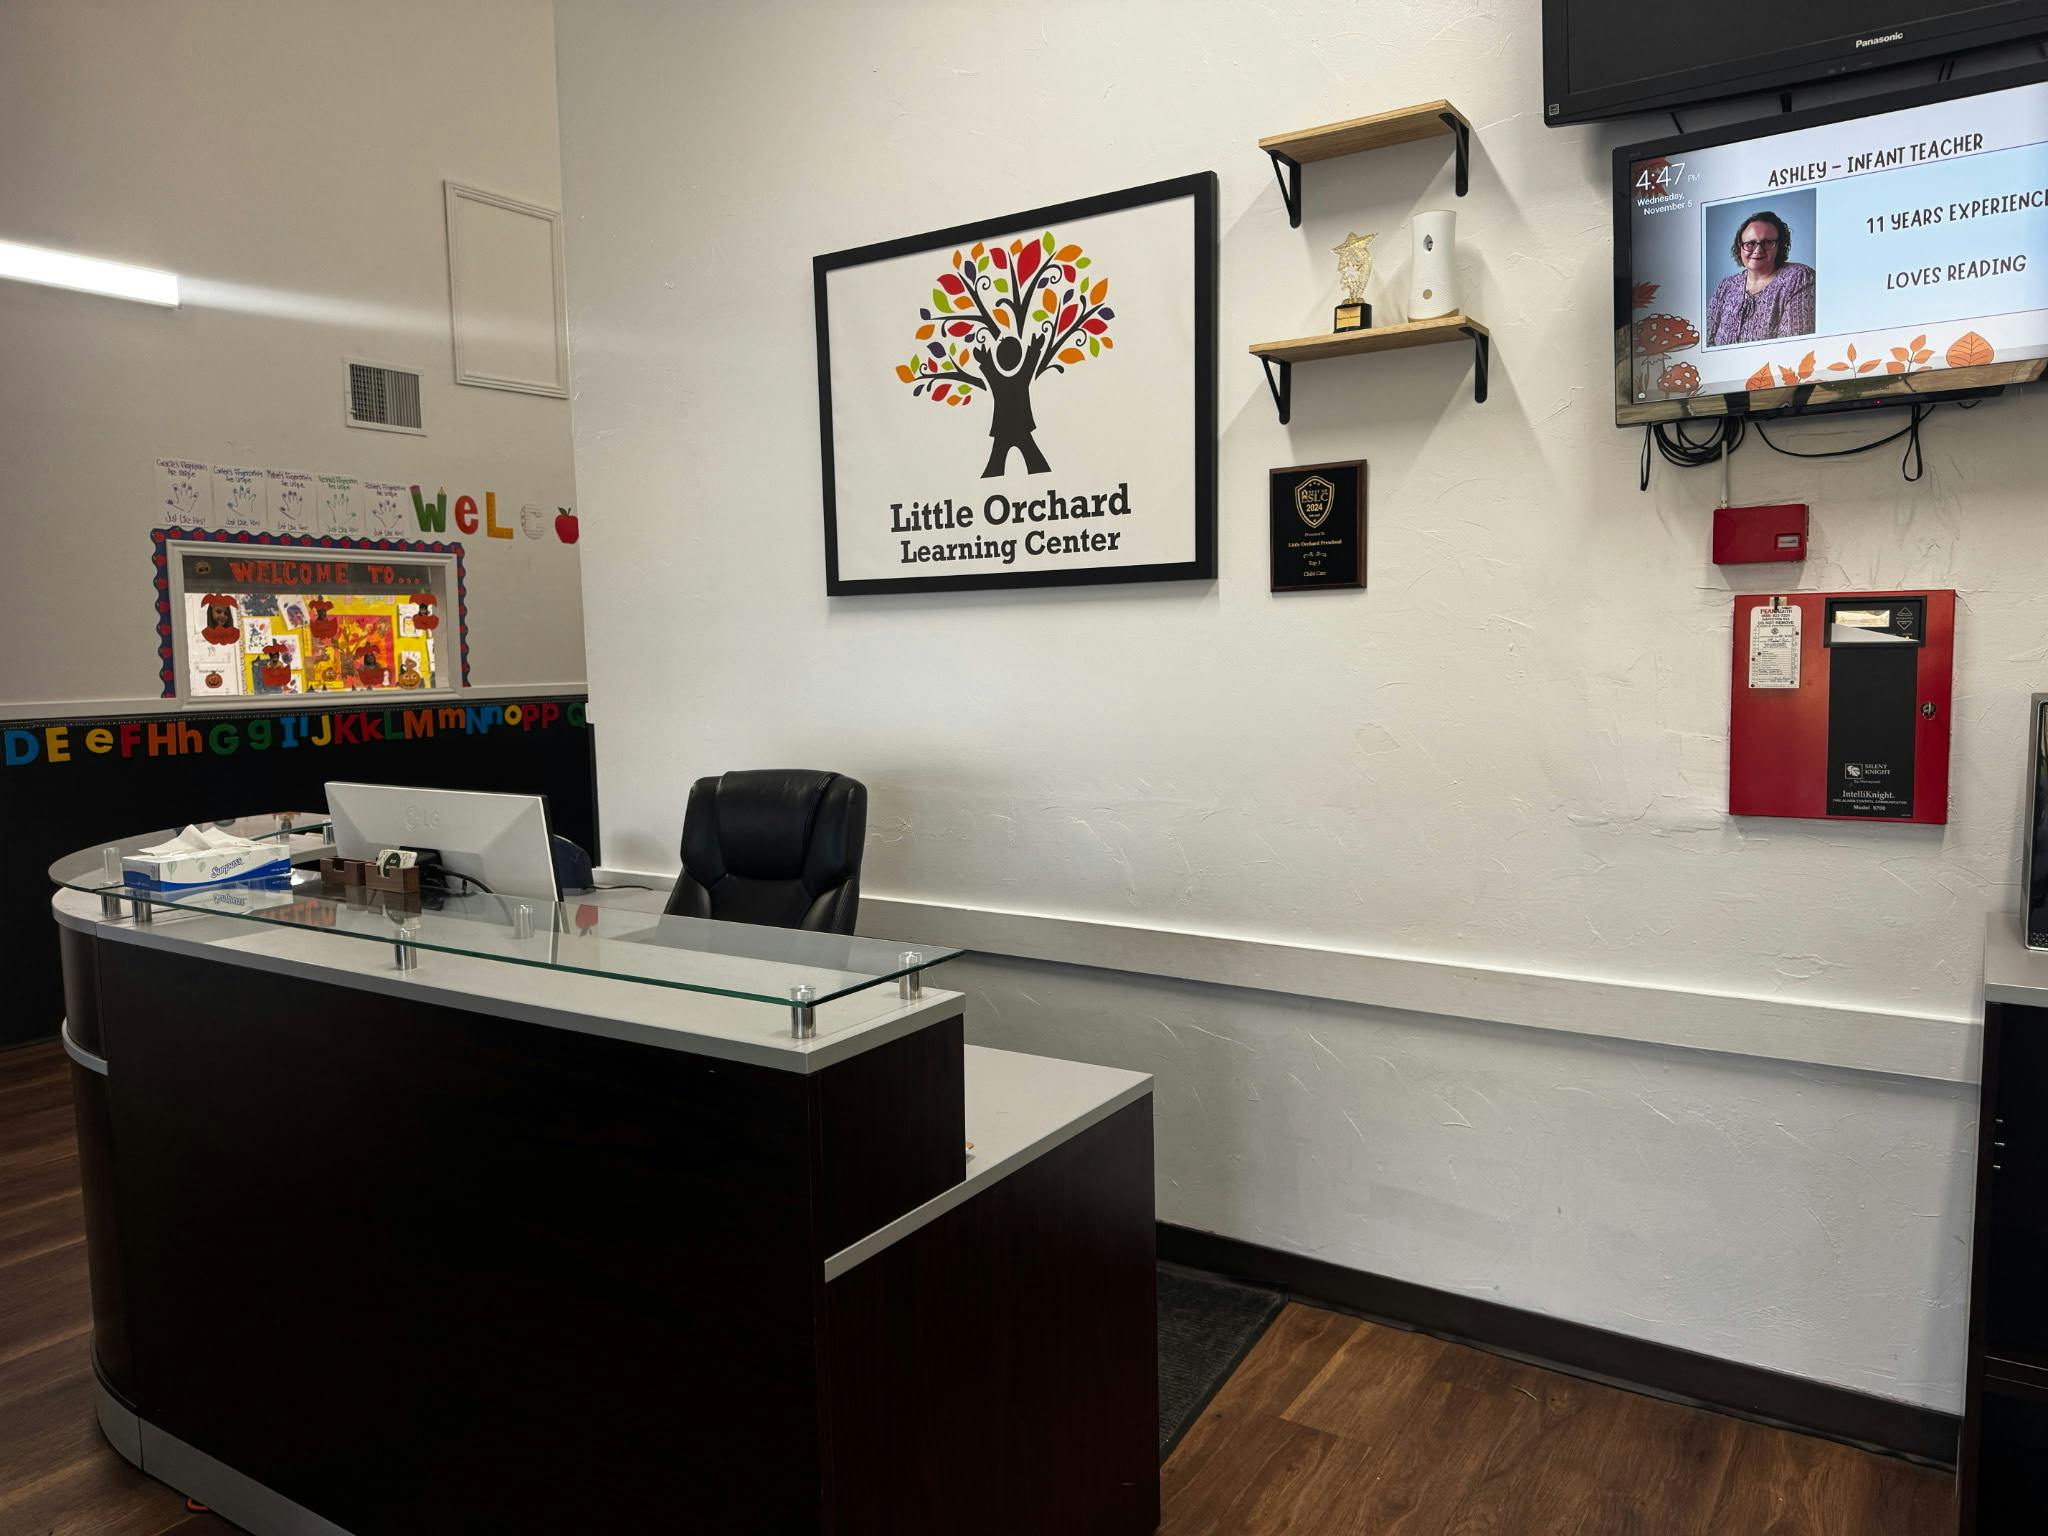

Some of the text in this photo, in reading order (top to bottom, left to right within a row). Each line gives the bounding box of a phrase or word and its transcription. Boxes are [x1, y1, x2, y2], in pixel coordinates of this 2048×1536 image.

[1855, 31, 1904, 49] Panasonic
[1767, 161, 1827, 188] ASHLEY
[1847, 146, 1906, 174] INFANT
[1909, 132, 1984, 162] TEACHER
[1635, 162, 1700, 191] 4:47 PM
[1637, 192, 1685, 207] Wednesday,
[1643, 202, 1686, 216] November
[1866, 215, 1885, 234] 11
[1890, 206, 1943, 231] YEARS
[1886, 254, 2028, 290] LOVES READING
[889, 482, 1132, 533] Little Orchard
[1306, 503, 1323, 512] 2024
[1308, 492, 1329, 503] SLC
[900, 528, 1121, 565] Learning Center
[229, 560, 349, 586] WELCOME
